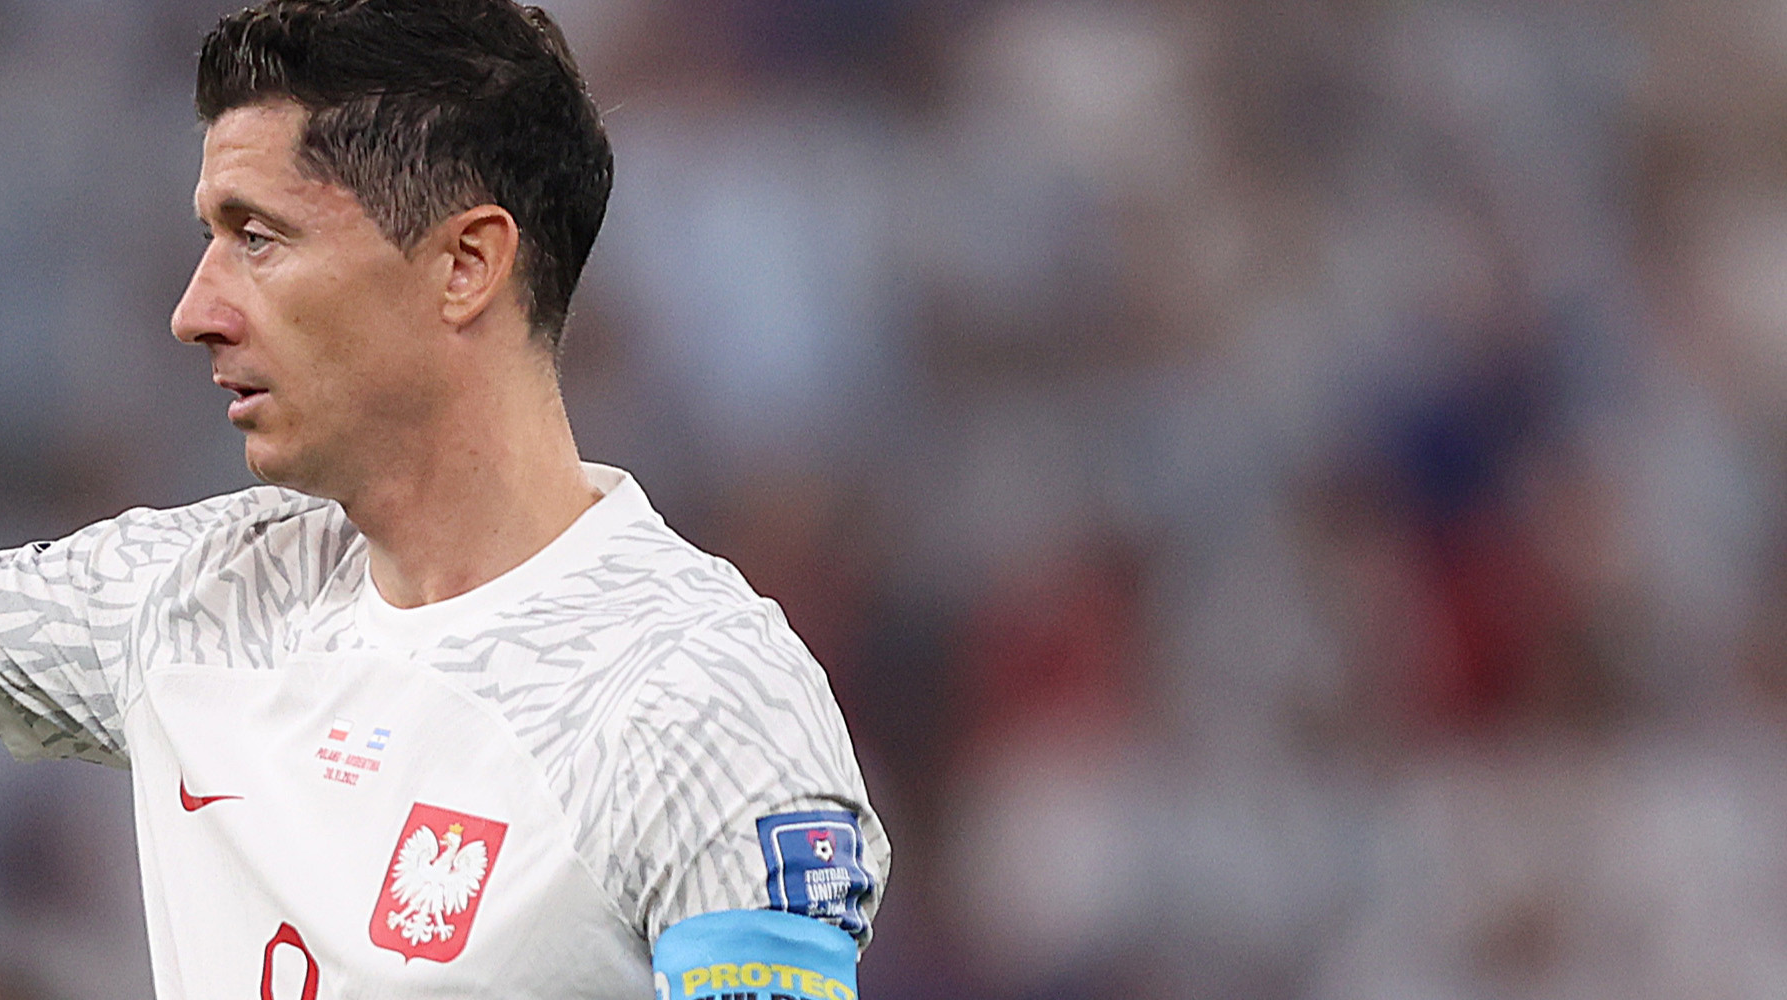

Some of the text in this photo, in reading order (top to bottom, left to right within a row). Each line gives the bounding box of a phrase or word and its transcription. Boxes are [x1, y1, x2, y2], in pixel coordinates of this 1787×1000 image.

[316, 748, 343, 762] POLAND
[346, 754, 381, 771] ARGENTINA
[805, 867, 850, 882] FOOTBALL
